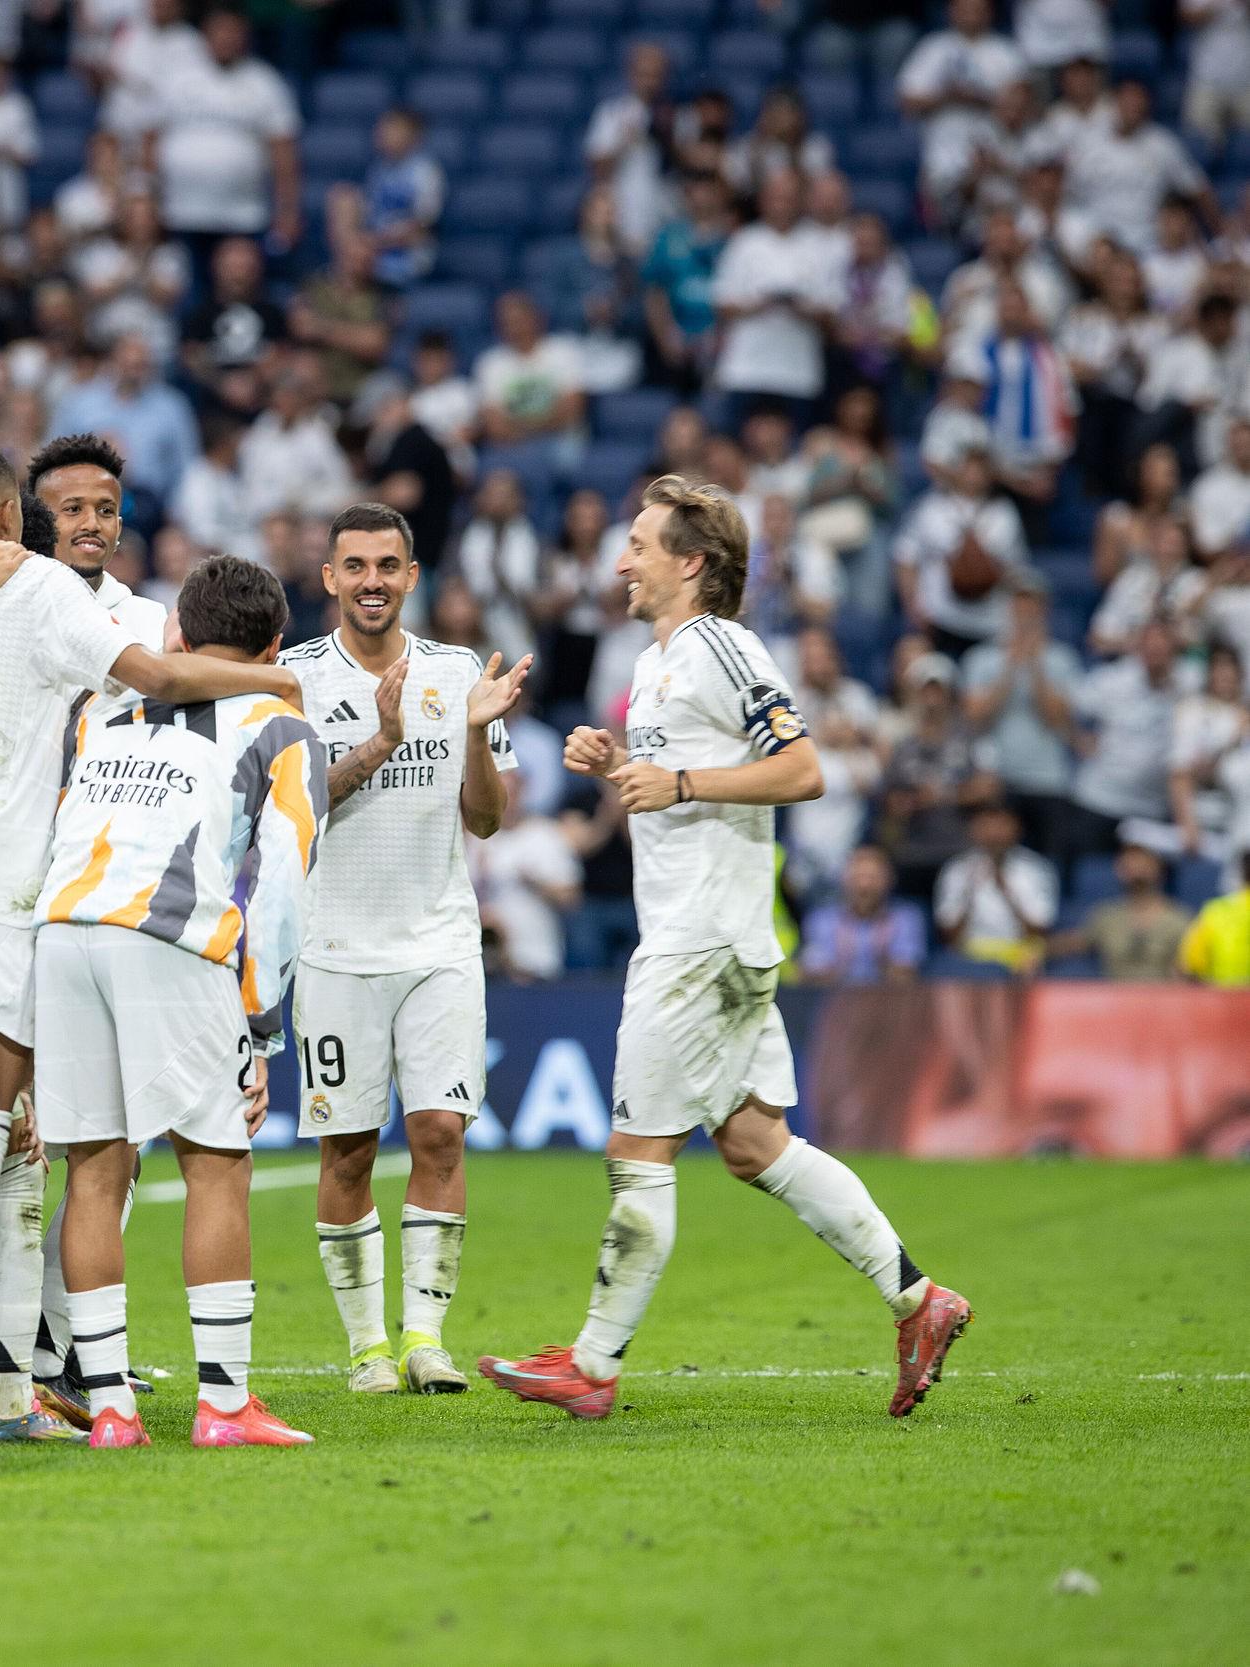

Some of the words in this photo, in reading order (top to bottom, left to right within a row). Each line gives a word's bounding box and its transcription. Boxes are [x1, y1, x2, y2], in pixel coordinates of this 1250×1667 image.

[80, 754, 197, 794] Emirates
[381, 765, 434, 789] BETTER
[109, 783, 169, 808] BETTER
[303, 1034, 346, 1089] 19
